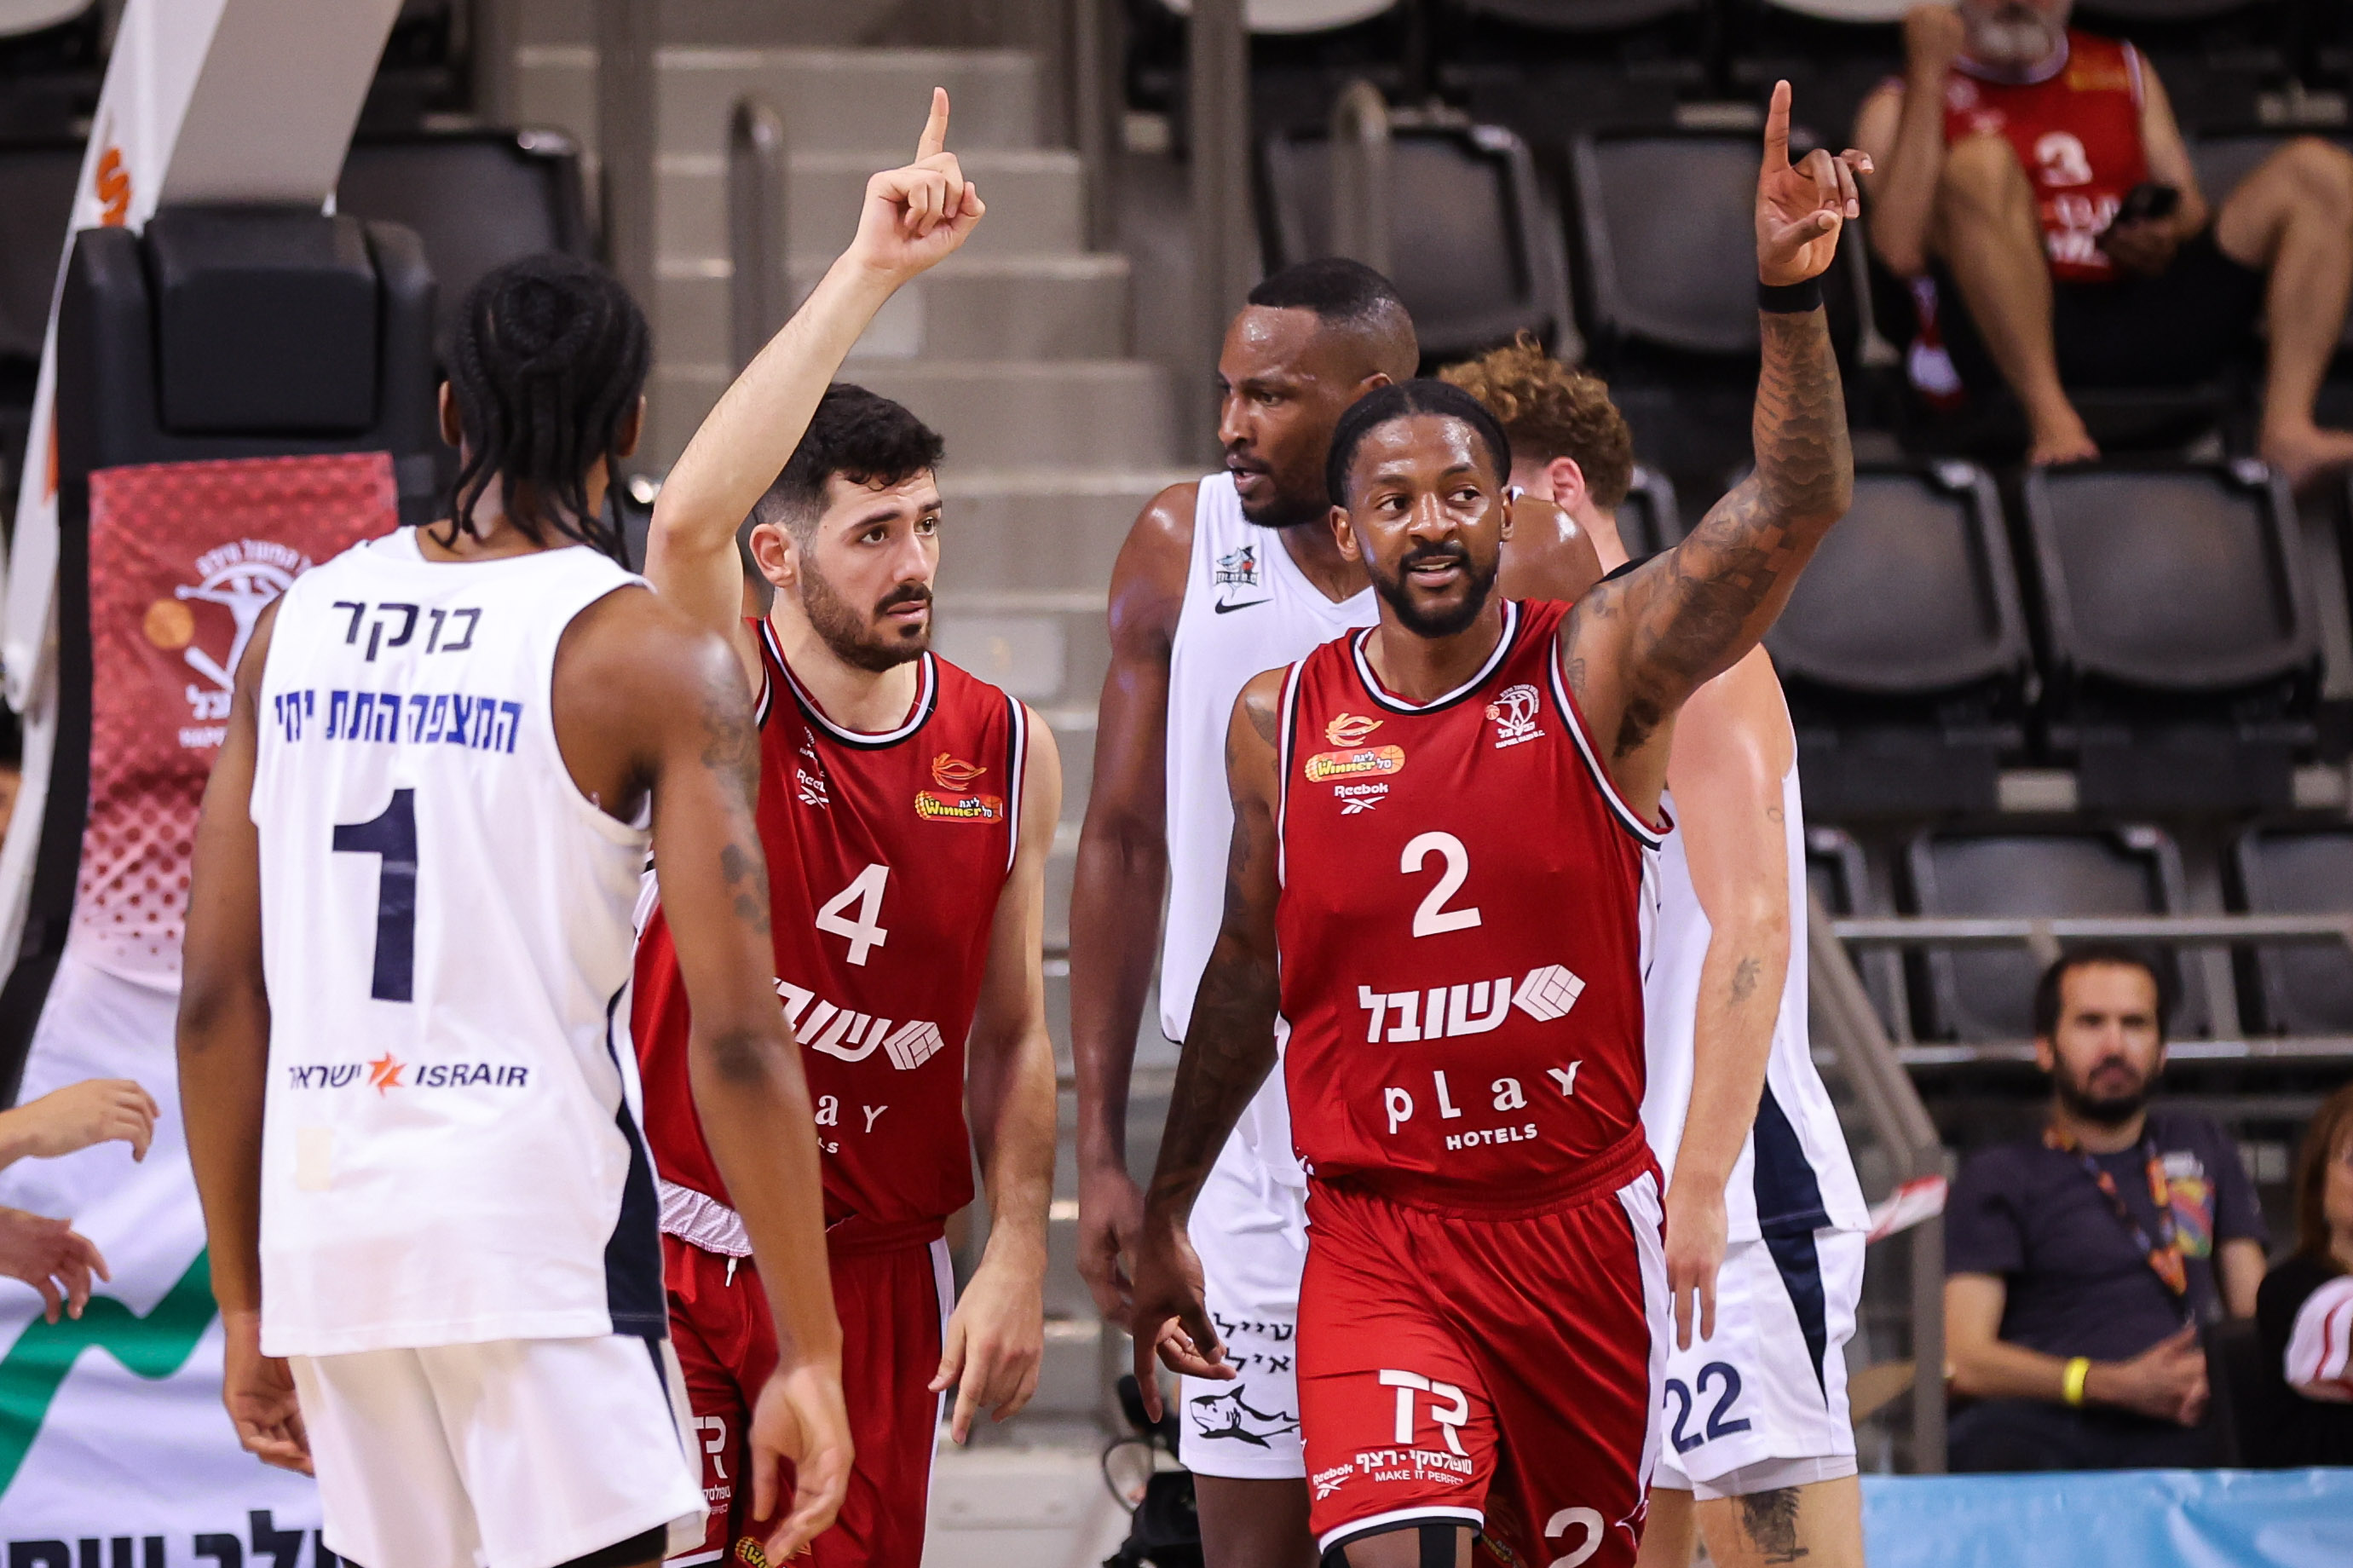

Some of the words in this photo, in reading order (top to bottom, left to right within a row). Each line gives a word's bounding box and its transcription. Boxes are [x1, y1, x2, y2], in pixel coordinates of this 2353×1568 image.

[326, 690, 401, 744] התת
[1317, 758, 1376, 777] Winner
[1334, 782, 1389, 798] Reebok
[924, 798, 982, 818] Winner
[332, 788, 418, 1003] 1
[1399, 831, 1482, 937] 2
[816, 863, 890, 966] 4
[773, 977, 893, 1063] שוב
[1358, 977, 1513, 1043] שובל
[415, 1063, 529, 1088] ISRAIR
[1445, 1123, 1538, 1150] HOTELS
[1378, 1369, 1470, 1457] TR
[1663, 1361, 1752, 1455] 22
[1312, 1463, 1353, 1487] Reebok
[1375, 1470, 1411, 1483] MAKE
[1415, 1469, 1426, 1481] IT
[1544, 1506, 1605, 1568] 2
